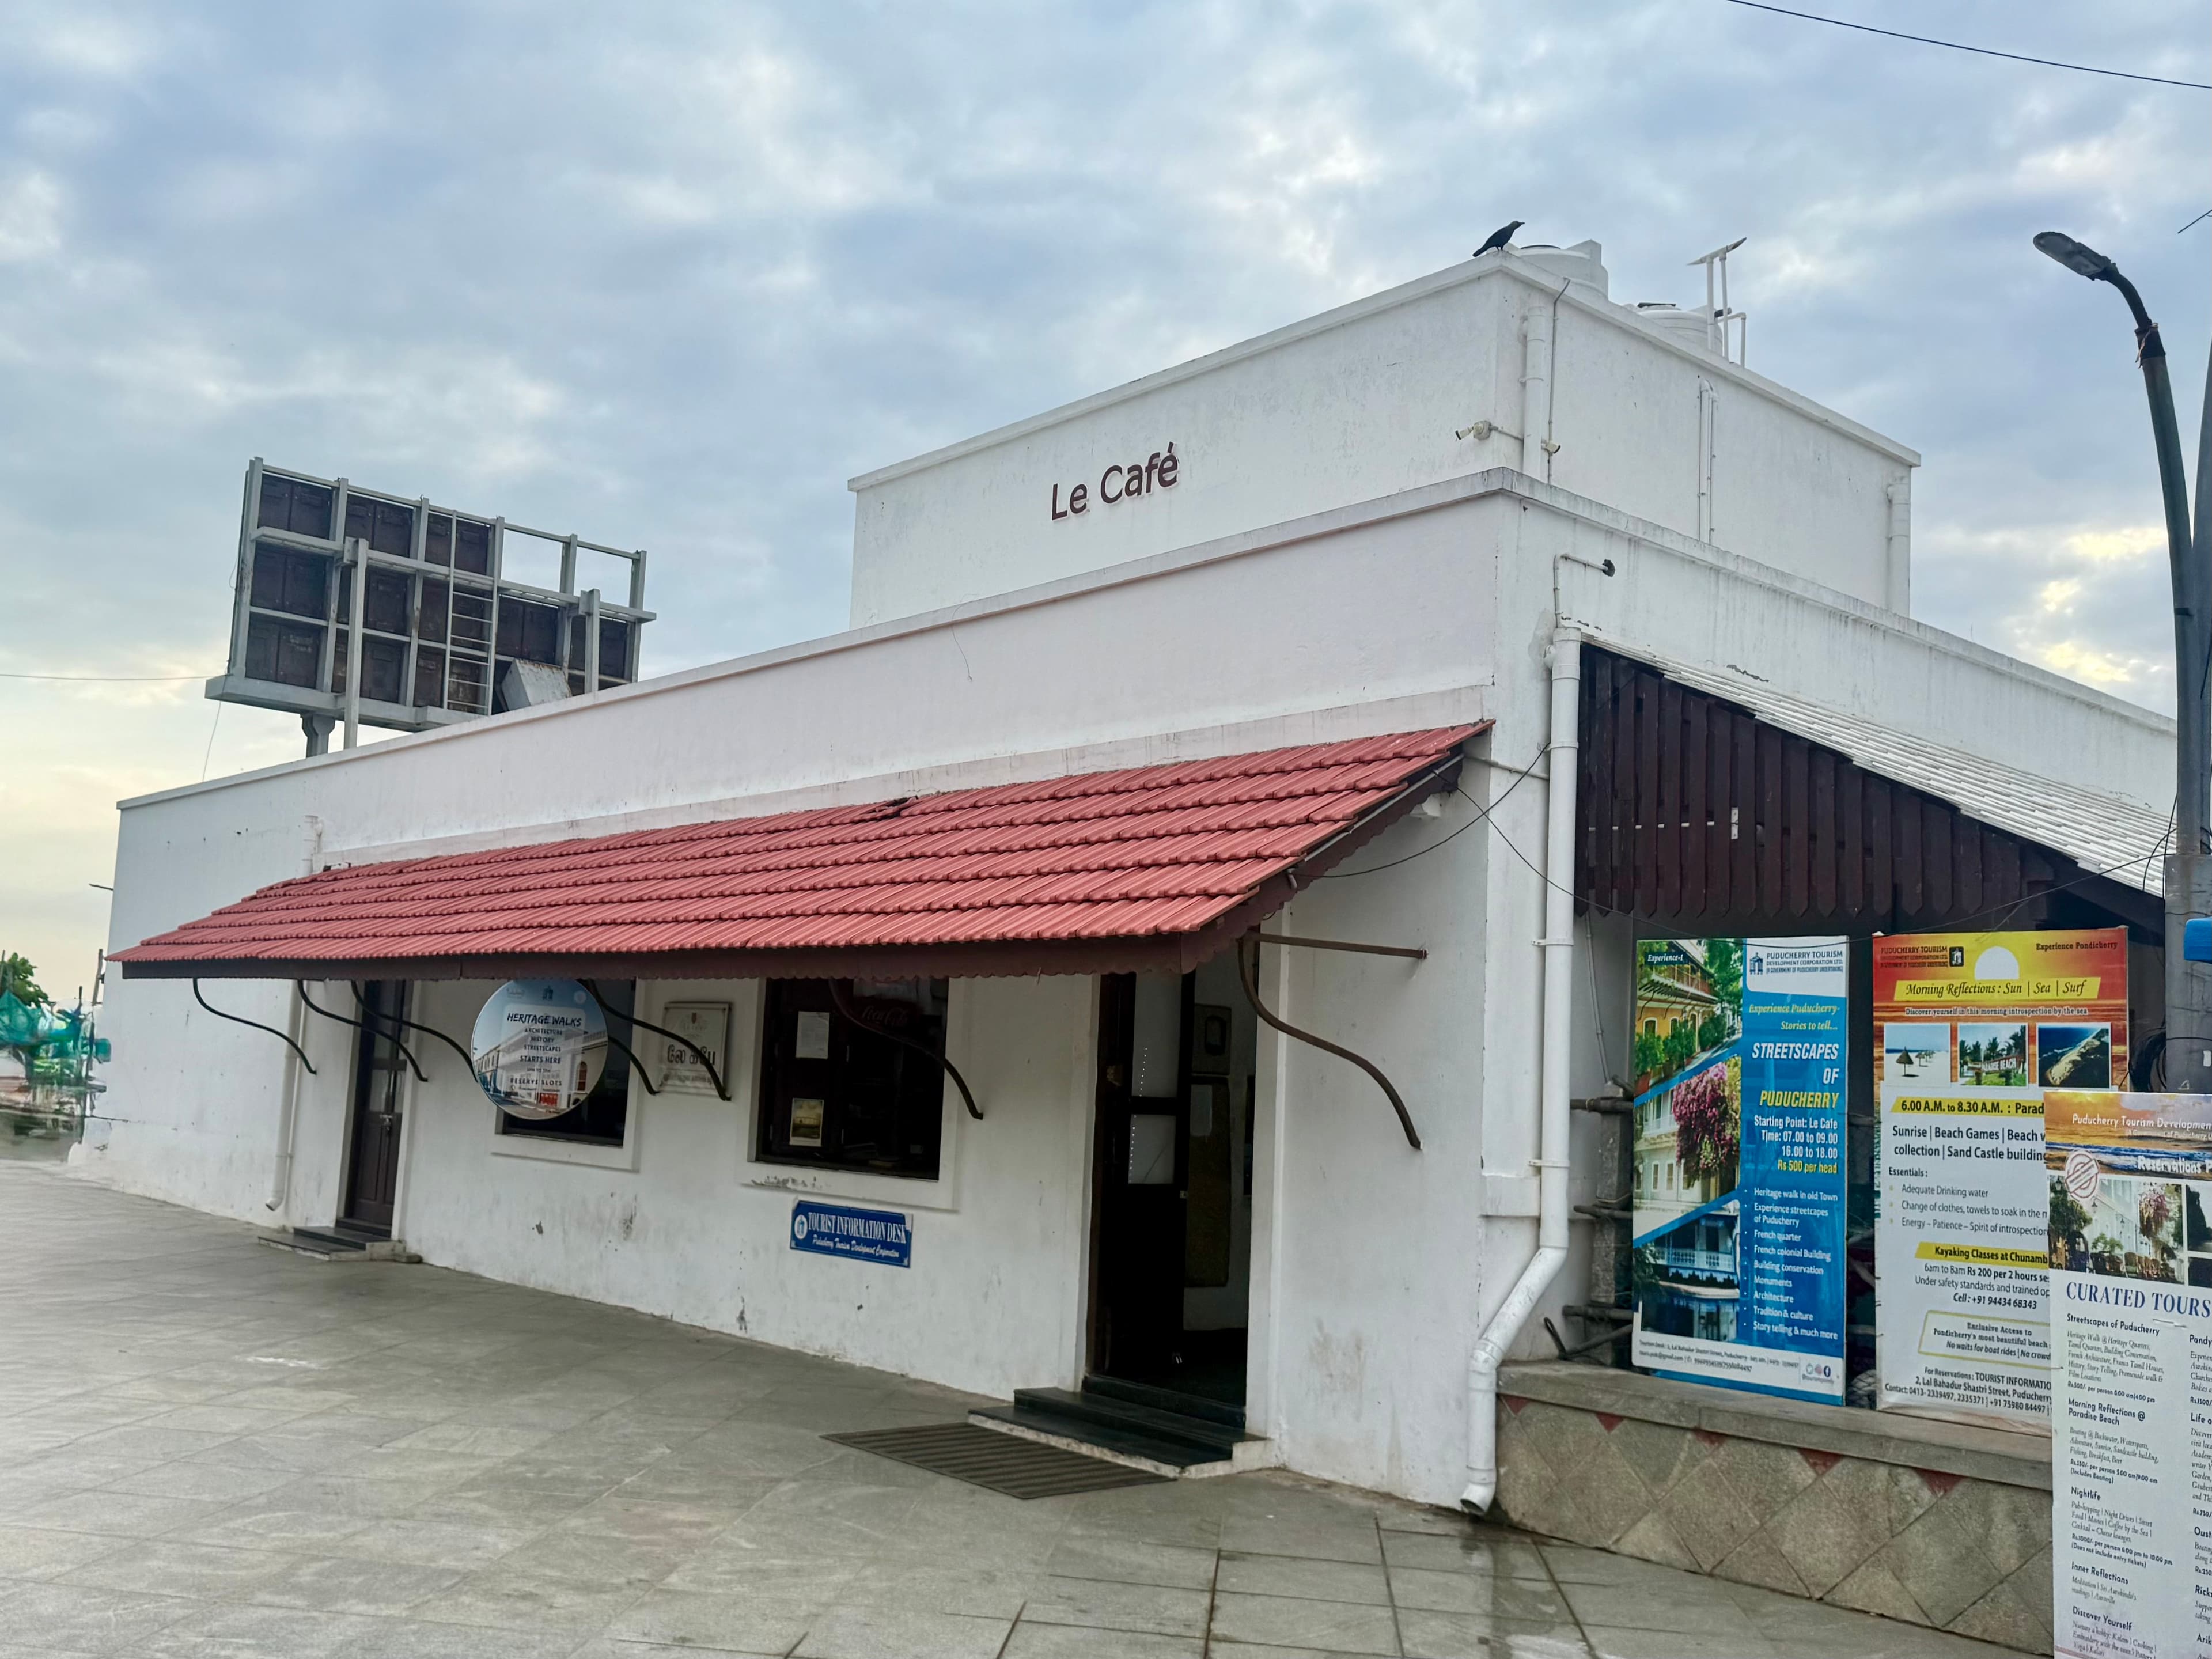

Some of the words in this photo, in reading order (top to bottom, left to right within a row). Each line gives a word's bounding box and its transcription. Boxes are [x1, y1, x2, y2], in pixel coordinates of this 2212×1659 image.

[1052, 484, 1088, 521] Le
[1100, 441, 1178, 503] Café
[2036, 942, 2074, 951] Experience
[2076, 941, 2118, 950] Pondicherry
[1906, 984, 1944, 998] Morning
[2003, 983, 2022, 994] Sun
[2033, 982, 2050, 994] Sea
[2062, 980, 2087, 996] Surf
[1749, 1003, 1790, 1016] Experience
[1933, 1007, 1958, 1017] yourself
[1981, 1008, 2007, 1016] morning
[2009, 1007, 2052, 1016] introspection
[2054, 1007, 2062, 1016] by
[507, 1013, 550, 1024] HERITAGE
[552, 1016, 581, 1026] WALKS
[1781, 1020, 1806, 1030] Stories
[525, 1027, 563, 1035] ARCHITECTURE
[1752, 1043, 1839, 1060] STREETSCAPES
[1823, 1068, 1839, 1084] OF
[1760, 1091, 1839, 1108] PUDUCHERRY
[1902, 1101, 1921, 1111] 6.00
[1924, 1101, 1945, 1112] A.M.
[1957, 1103, 1978, 1112] 8.30
[1981, 1103, 2003, 1113] A.M.
[1754, 1115, 1783, 1129] Starting
[1809, 1118, 1818, 1128] Le
[2073, 1113, 2119, 1128] Puducherry
[2121, 1115, 2154, 1127] Tourism
[1783, 1131, 1804, 1142] 07.00
[1806, 1132, 1814, 1143] to
[1816, 1133, 1838, 1144] 09.00
[1893, 1126, 1927, 1138] Sunrise
[1935, 1127, 1963, 1138] Beach
[1966, 1128, 1999, 1139] Games
[2007, 1129, 2037, 1141] Beach
[1805, 1147, 1813, 1157] to
[1816, 1147, 1838, 1159] 18.00
[1894, 1144, 1940, 1156] collection
[1948, 1146, 1971, 1157] Sand
[1975, 1147, 2004, 1159] Castle
[1778, 1160, 1786, 1170] Rs
[1789, 1161, 1802, 1172] 500
[1804, 1164, 1817, 1173] per
[1819, 1162, 1837, 1173] head
[2137, 1155, 2201, 1174] Reservations
[1754, 1188, 1782, 1199] Heritage
[1783, 1190, 1798, 1198] walk
[1800, 1191, 1806, 1199] in
[1820, 1192, 1838, 1201] Town
[1902, 1185, 1935, 1195] Adequate
[1937, 1186, 1966, 1198] Drinking
[1968, 1188, 1988, 1197] water
[1754, 1203, 1789, 1213] Experience
[1902, 1201, 1927, 1211] Change
[1930, 1202, 1937, 1211] of
[1967, 1205, 1990, 1215] towels
[1992, 1207, 1999, 1215] to
[2001, 1206, 2017, 1216] soak
[2020, 1207, 2026, 1217] in
[2028, 1207, 2040, 1218] the
[808, 1212, 836, 1233] TOURIST
[836, 1215, 886, 1240] INFORMATION
[887, 1223, 906, 1244] DESK
[1754, 1214, 1762, 1223] of
[1763, 1215, 1800, 1228] Puducherry
[1902, 1218, 1925, 1229] Energy
[1933, 1219, 1963, 1230] Patience
[1970, 1221, 1988, 1232] Spirit
[1990, 1223, 1998, 1232] of
[1754, 1230, 1776, 1238] French
[1754, 1245, 1775, 1254] French
[1777, 1248, 1802, 1257] colonial
[1935, 1246, 1969, 1259] Kayaking
[1971, 1248, 1998, 1260] Classes
[2001, 1252, 2008, 1261] at
[1754, 1260, 1780, 1273] Building
[1782, 1264, 1824, 1275] conservation
[1925, 1264, 1939, 1272] 6am
[1967, 1267, 1975, 1275] Rs
[1978, 1268, 1991, 1277] 200
[1994, 1270, 2006, 1280] per
[2008, 1270, 2013, 1278] 2
[2015, 1270, 2037, 1281] hours
[1915, 1275, 1936, 1286] Under
[1938, 1277, 1958, 1289] safety
[1960, 1279, 1995, 1291] standards
[1997, 1282, 2010, 1293] and
[2013, 1284, 2039, 1295] trained
[1754, 1291, 1794, 1303] Architecture
[1972, 1295, 1986, 1304] +91
[1988, 1296, 2012, 1306] 94434
[2013, 1300, 2037, 1309] 68343
[2067, 1282, 2145, 1308] CURATED
[2152, 1293, 2211, 1318] TOURS
[1790, 1312, 1813, 1321] culture
[1753, 1321, 1770, 1333] Story
[1794, 1327, 1799, 1335] &
[1800, 1328, 1819, 1337] much
[1820, 1332, 1838, 1340] more
[1967, 1322, 1998, 1332] Exclusive
[2000, 1325, 2022, 1335] Access
[2025, 1328, 2032, 1336] to
[2067, 1313, 2108, 1327] Streetscapes
[2111, 1320, 2118, 1328] of
[2120, 1321, 2160, 1336] Puducherry
[1946, 1340, 1955, 1349] No
[1974, 1343, 1983, 1353] for
[1984, 1344, 1999, 1354] boat
[2001, 1347, 2016, 1356] rides
[2020, 1349, 2029, 1357] No
[1978, 1334, 1995, 1342] most
[1997, 1335, 2027, 1346] beautiful
[2028, 1338, 2048, 1349] beach
[1925, 1366, 1933, 1374] For
[1975, 1372, 2005, 1383] TOURIST
[1922, 1377, 1932, 1387] Lal
[1934, 1379, 1961, 1391] Bahadur
[1964, 1382, 1987, 1393] Shastri
[2069, 1397, 2096, 1411] Morning
[2098, 1403, 2135, 1418] Reflections
[2138, 1411, 2145, 1421] @
[2069, 1407, 2097, 1421] Paradise
[2099, 1414, 2119, 1425] Beach
[2191, 1412, 2205, 1424] Life
[2071, 1486, 2101, 1501] Nightlife
[2072, 1561, 2089, 1573] Inner
[2091, 1567, 2128, 1584] Reflections
[2073, 1606, 2101, 1622] Discover
[2103, 1614, 2132, 1631] Yourself
[2197, 1633, 2212, 1645] Arik
